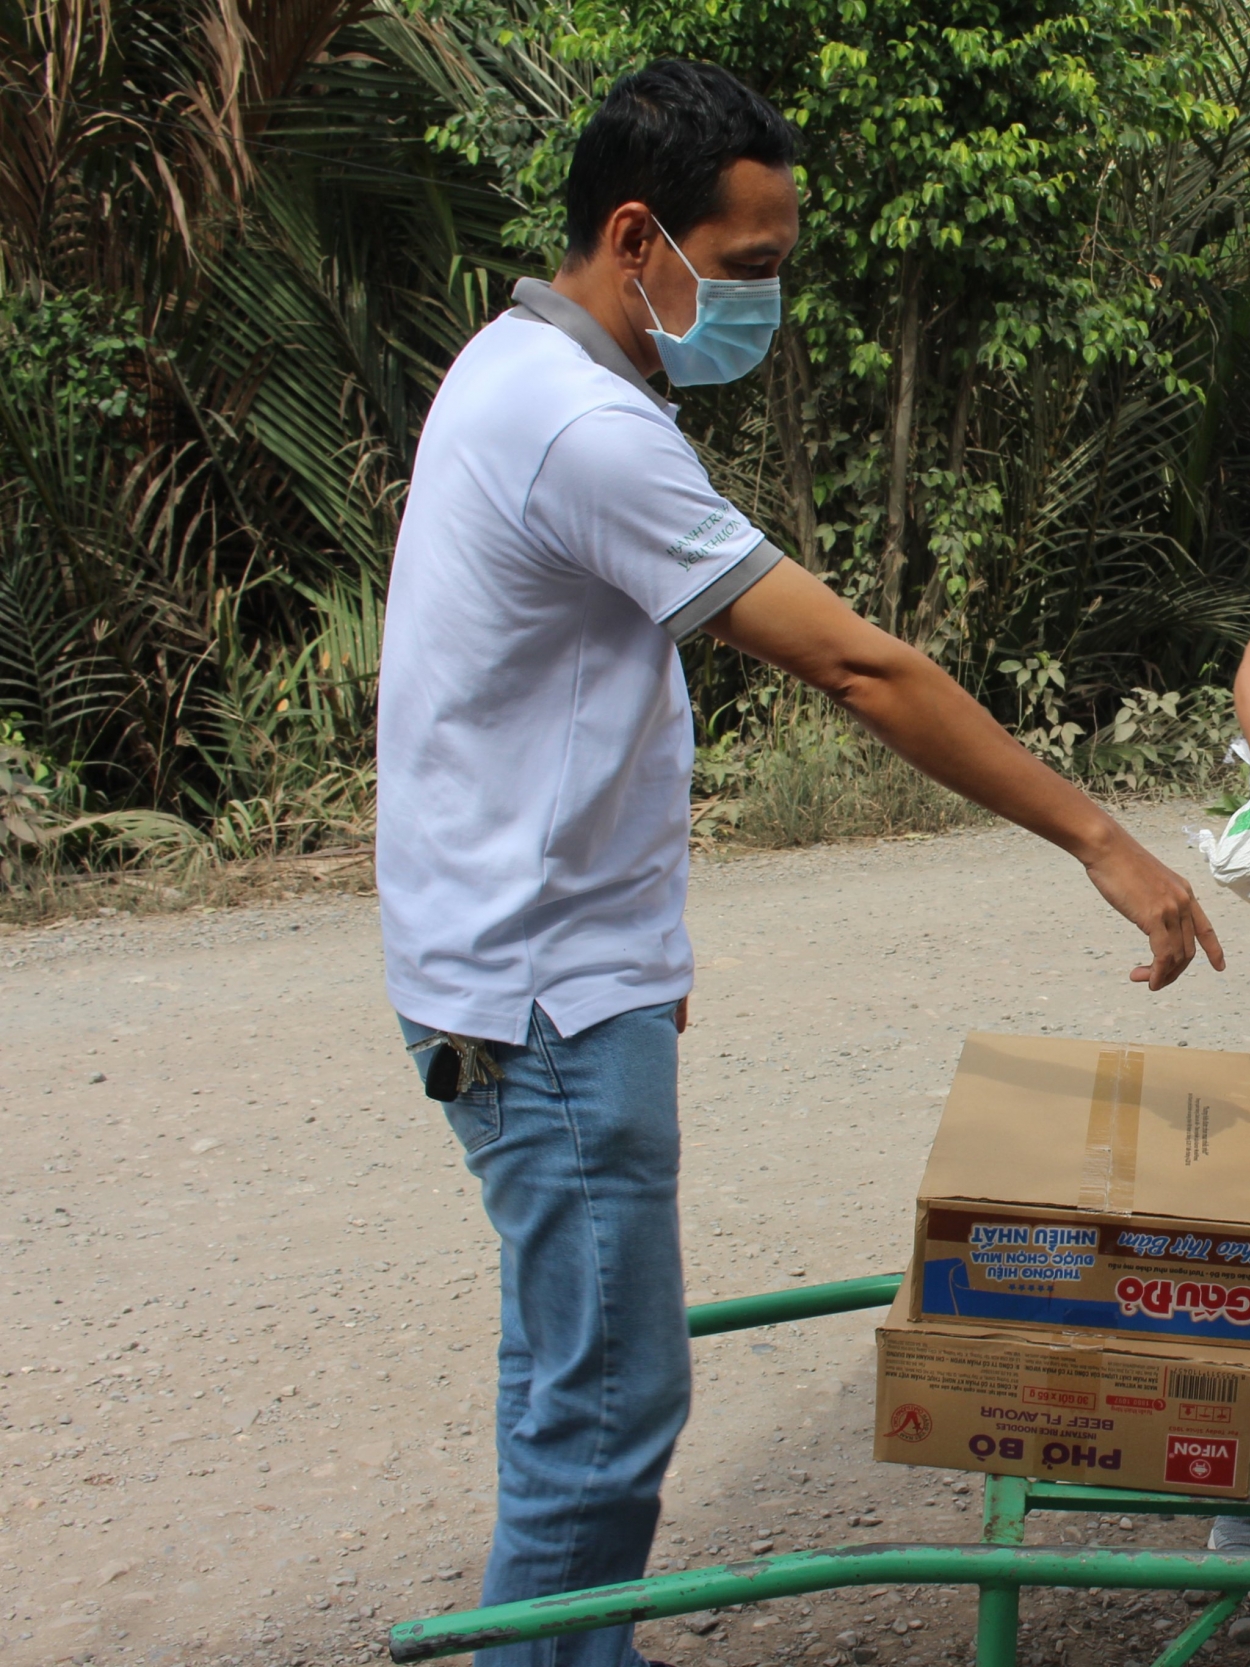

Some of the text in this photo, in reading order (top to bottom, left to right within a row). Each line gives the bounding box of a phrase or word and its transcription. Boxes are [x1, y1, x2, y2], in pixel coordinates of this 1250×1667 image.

[970, 1226, 1097, 1252] NHIỀU NHẤT
[1170, 1234, 1212, 1261] Thịt
[971, 1250, 1095, 1266] ĐƯỢC CHỌN MUA
[986, 1264, 1081, 1281] THƯƠNG HIỆU
[1169, 1267, 1188, 1276] ngon
[999, 1362, 1013, 1370] CÔNG
[1030, 1389, 1035, 1397] g
[1038, 1392, 1048, 1400] 65
[1059, 1393, 1074, 1404] GÓI
[1077, 1396, 1089, 1405] 30
[980, 1406, 1114, 1431] BEEF FLAVOUR
[996, 1422, 1096, 1440] INSTANT RICE NOODLES
[968, 1434, 1122, 1470] PHỞ BÒ
[1173, 1442, 1229, 1458] VIFON
